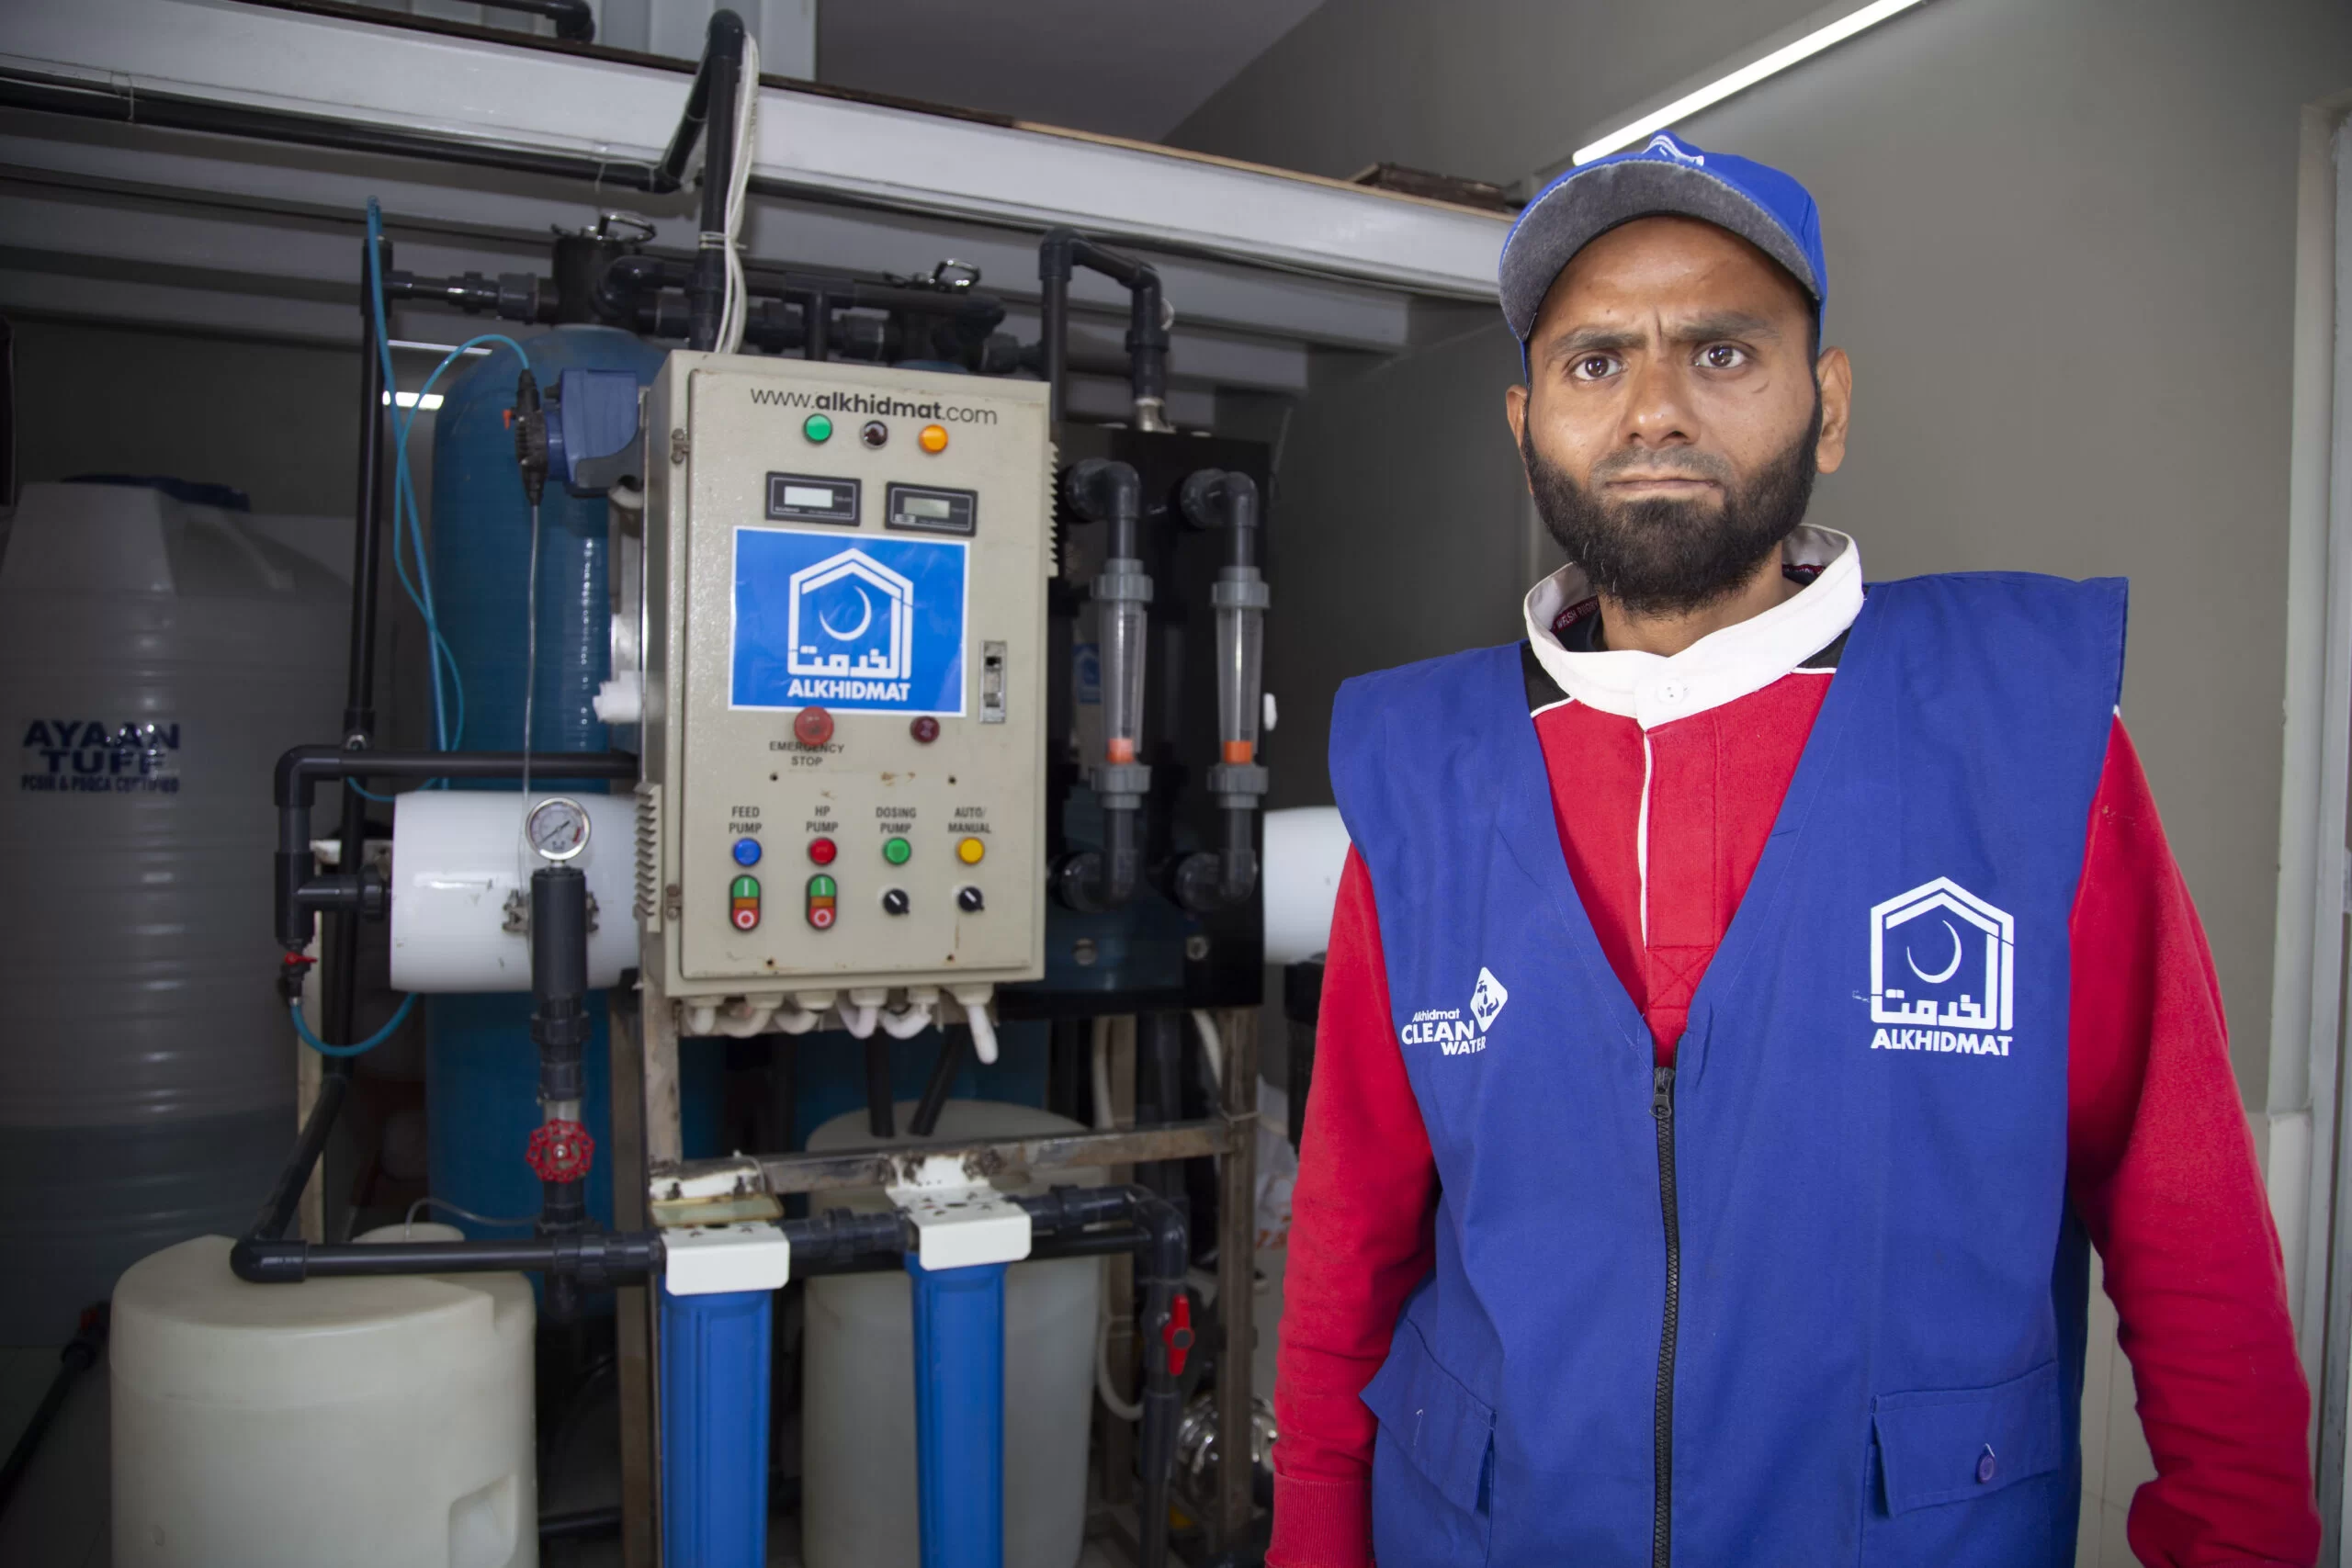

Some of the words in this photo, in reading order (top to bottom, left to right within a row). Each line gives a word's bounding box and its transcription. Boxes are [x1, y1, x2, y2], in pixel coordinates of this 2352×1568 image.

[751, 389, 998, 424] www.alkhidmat.com
[787, 679, 911, 702] ALKHIDMAT
[23, 719, 180, 750] AYAAN
[770, 740, 845, 753] EMERGENCY
[40, 750, 165, 774] TUFF
[791, 756, 823, 766] STOP
[731, 806, 760, 818] FEED
[815, 806, 831, 818] HP
[876, 807, 916, 818] DOSING
[729, 822, 762, 834] PUMP
[806, 821, 838, 833] PUMP
[879, 823, 911, 834] PUMP
[947, 823, 991, 834] MANUAL
[1401, 1020, 1474, 1044] CLEAN
[1441, 1035, 1487, 1055] WATER
[1871, 1028, 2013, 1056] ALKHIDMAT
